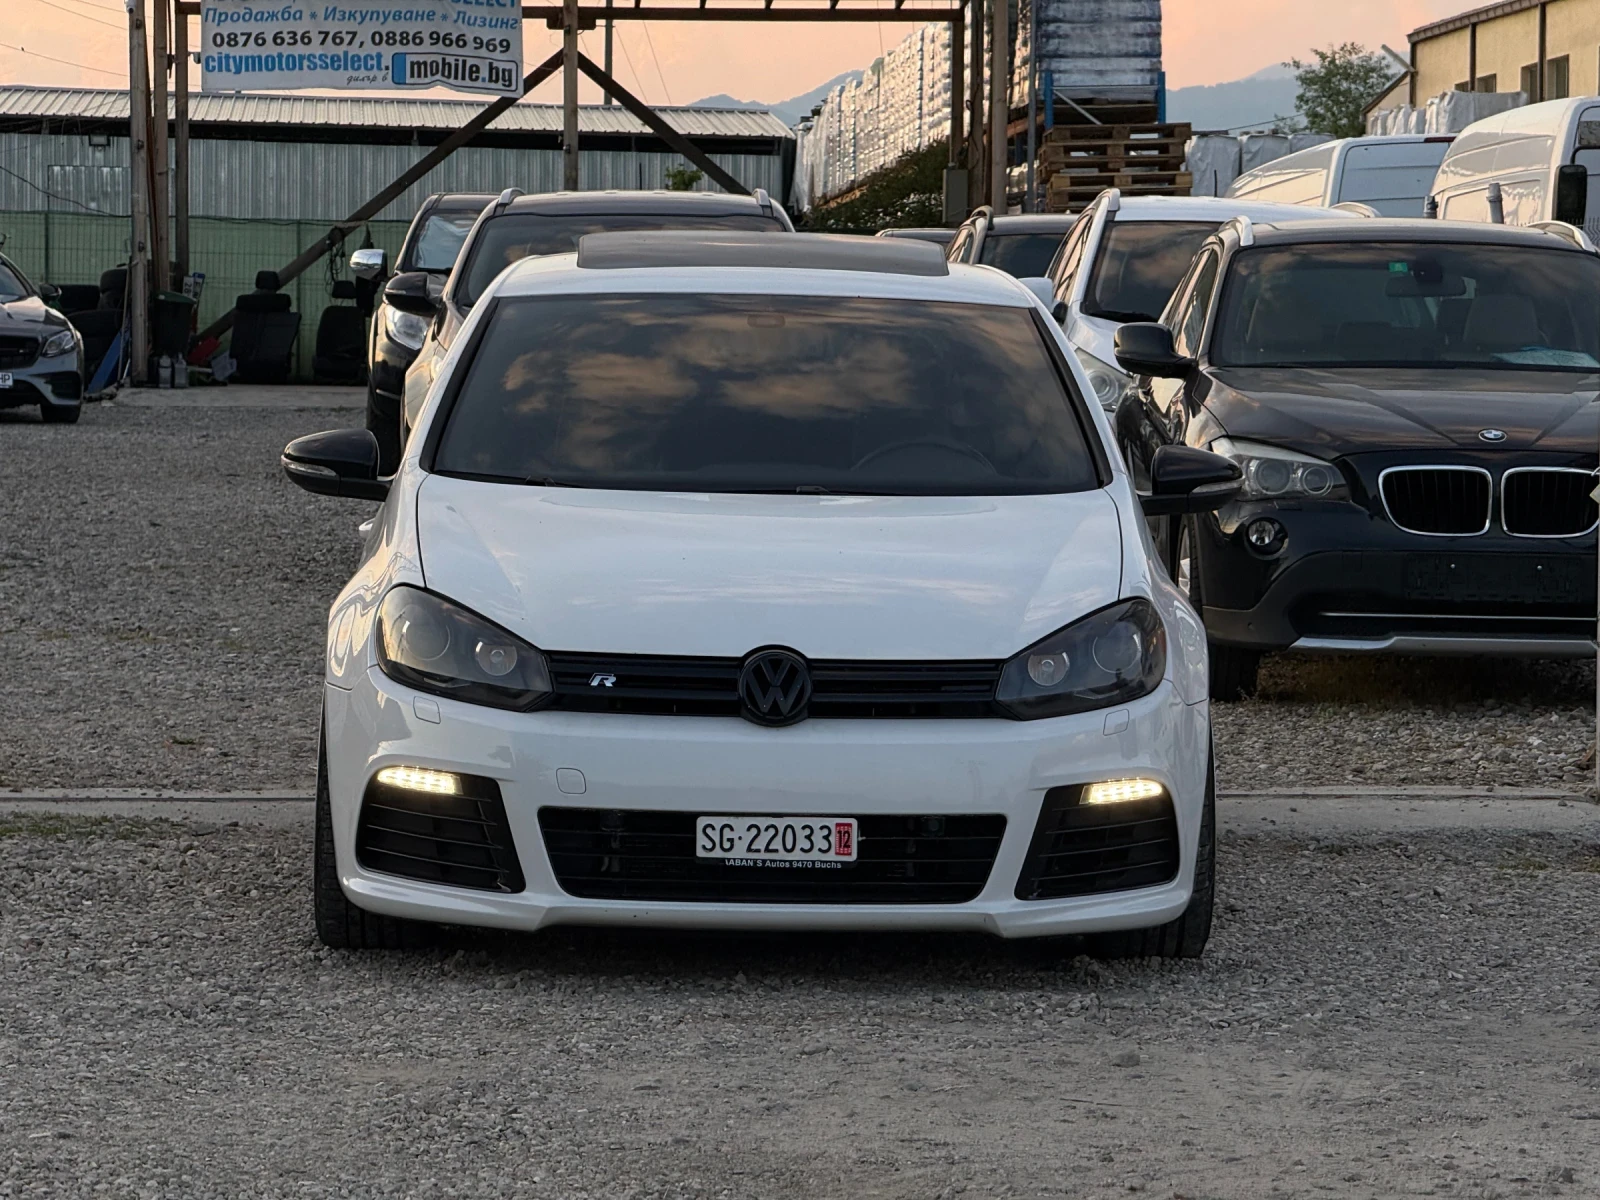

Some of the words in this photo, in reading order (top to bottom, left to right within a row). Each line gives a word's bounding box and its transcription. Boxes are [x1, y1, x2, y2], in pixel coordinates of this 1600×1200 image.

[204, 6, 303, 27] Продажба
[323, 6, 436, 25] Изкупуване
[453, 10, 519, 30] Лизинг
[212, 31, 267, 48] 0876
[272, 30, 312, 47] 636
[318, 30, 365, 48] 767,
[371, 30, 424, 47] 0886
[429, 31, 468, 49] 966
[473, 36, 511, 53] 969
[410, 57, 513, 88] mobile.bg
[589, 672, 617, 687] R
[745, 657, 806, 714] VW
[836, 830, 851, 848] 12
[765, 860, 790, 868] Autos
[792, 860, 812, 868] 9470
[814, 860, 842, 869] Buchs
